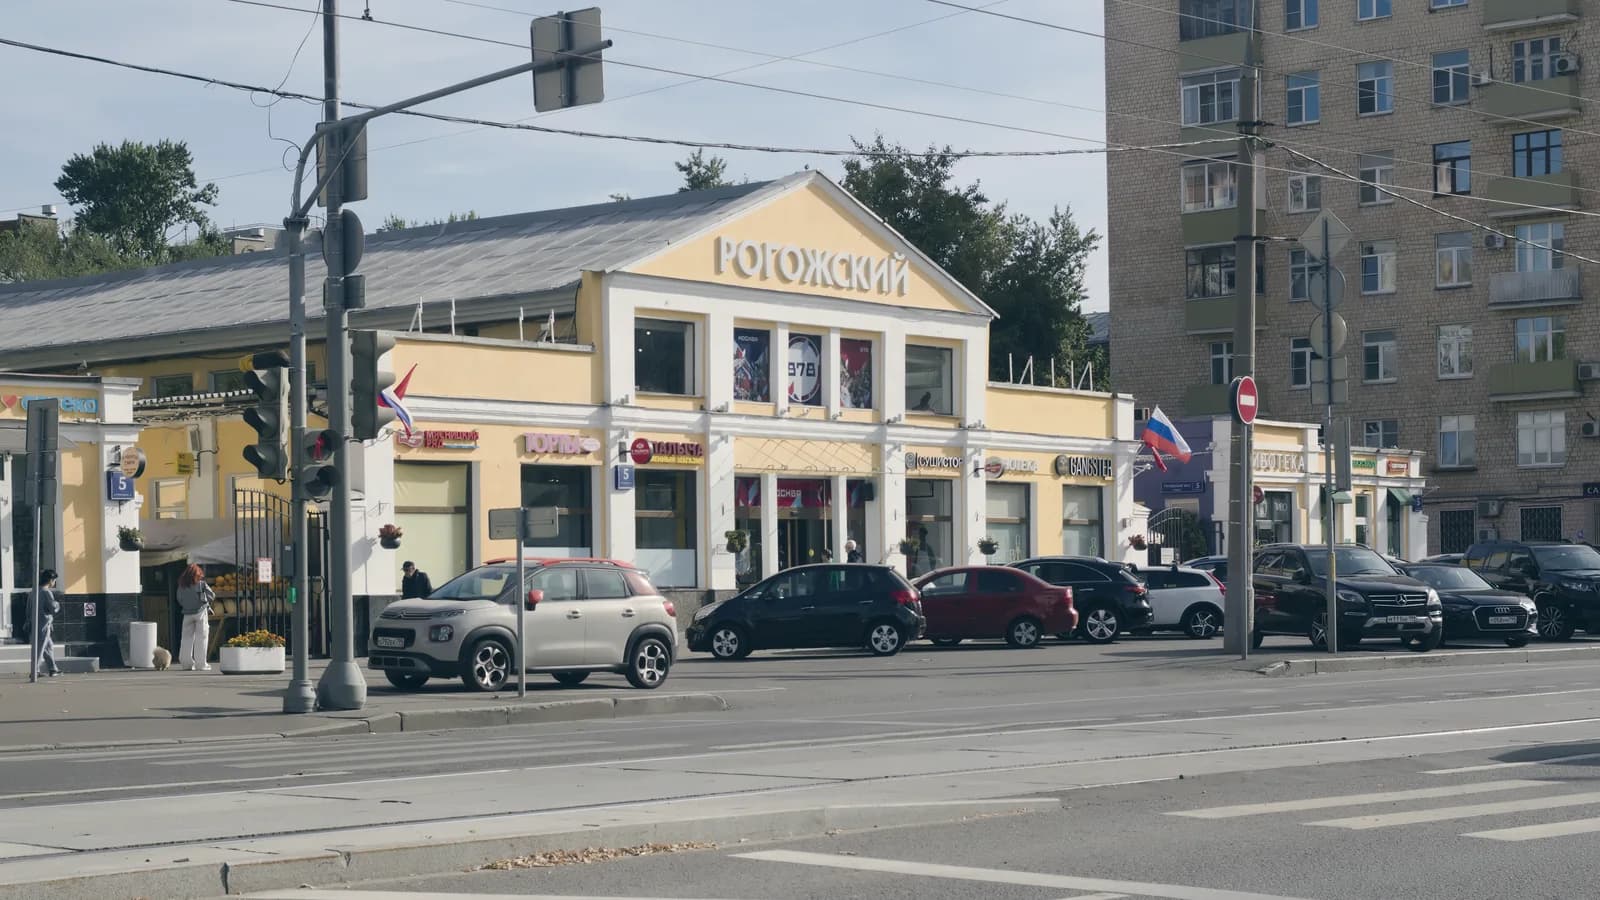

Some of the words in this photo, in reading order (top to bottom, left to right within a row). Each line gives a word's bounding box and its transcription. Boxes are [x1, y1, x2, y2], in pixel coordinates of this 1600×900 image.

[718, 235, 909, 295] РОГОЖСКИЙ
[623, 468, 629, 480] 5
[1070, 457, 1112, 477] GANGSTER
[118, 476, 127, 490] 5
[777, 489, 801, 497] ОСКВА
